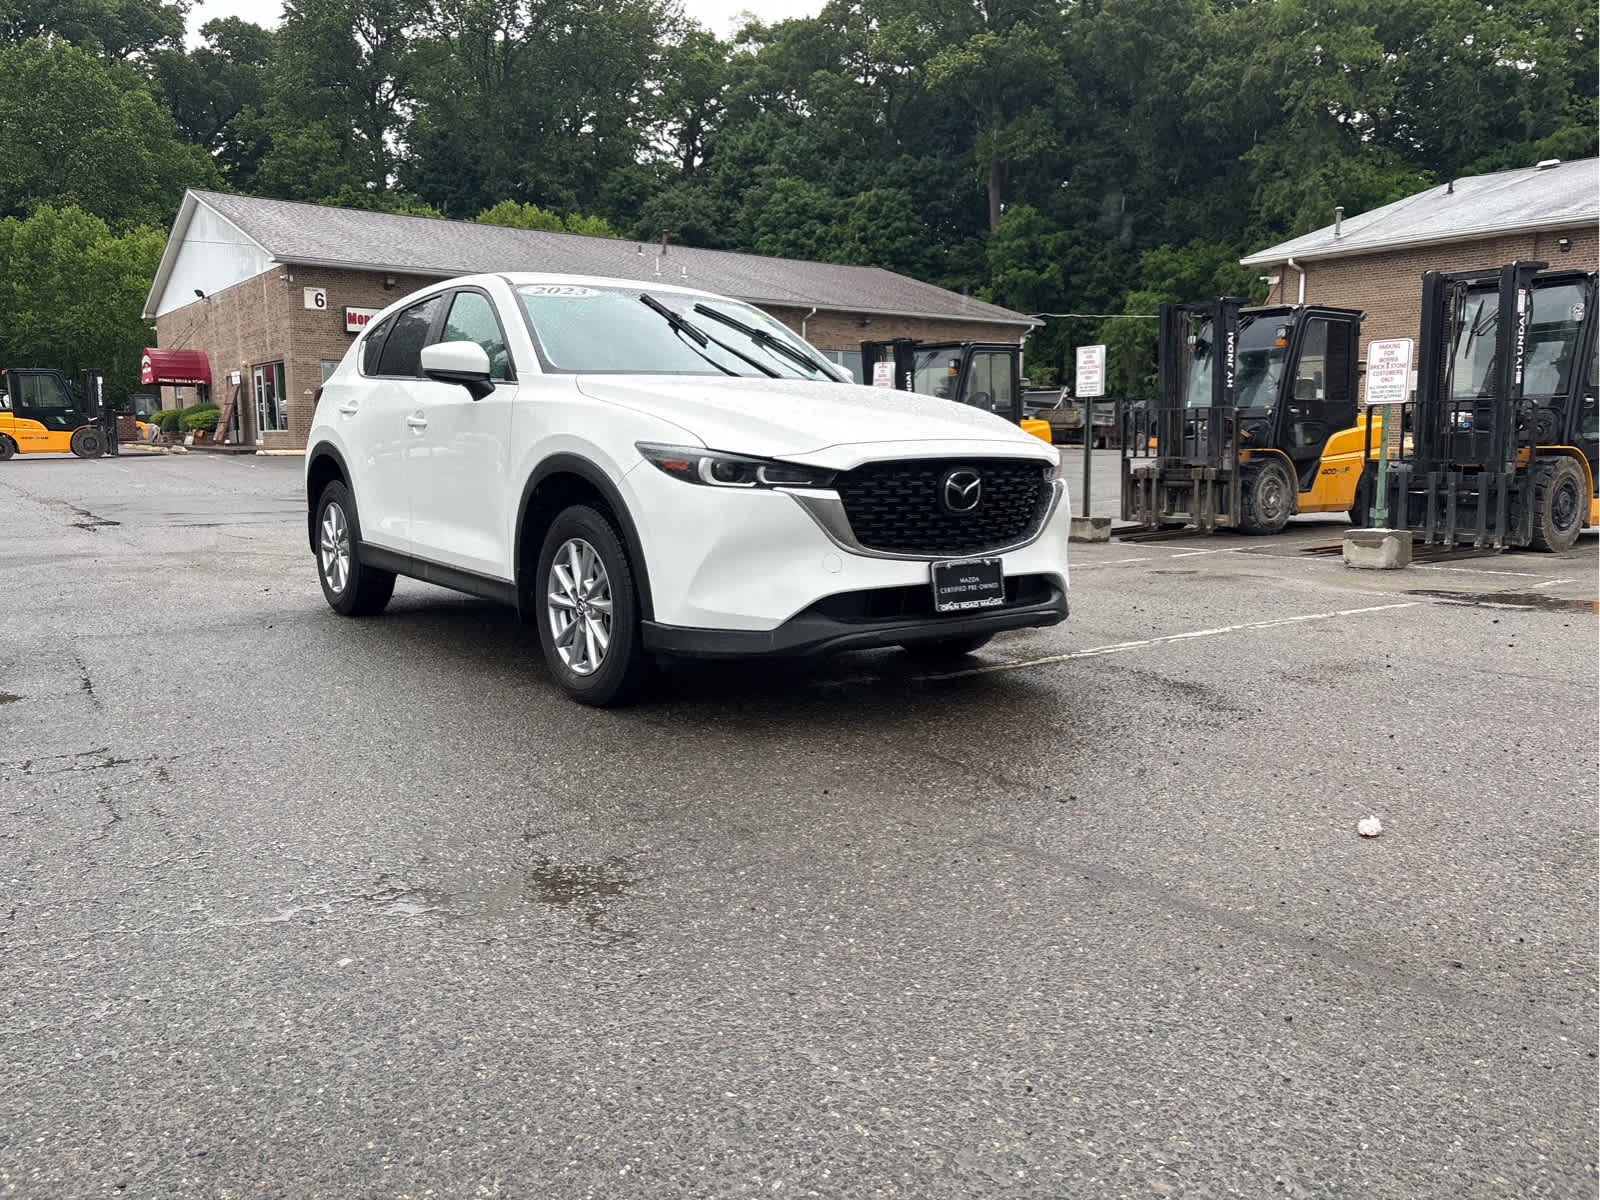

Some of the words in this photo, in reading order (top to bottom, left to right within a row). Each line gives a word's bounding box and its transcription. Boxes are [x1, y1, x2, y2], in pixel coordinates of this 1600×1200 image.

[532, 286, 588, 296] 2023
[314, 292, 325, 308] 6
[1515, 312, 1526, 375] HYUNDAI
[940, 585, 967, 594] CERTIFIED
[968, 582, 999, 591] PRE-OWNED
[940, 603, 960, 611] OPEN
[960, 601, 979, 609] ROAD
[980, 598, 1003, 607] MAZDA
